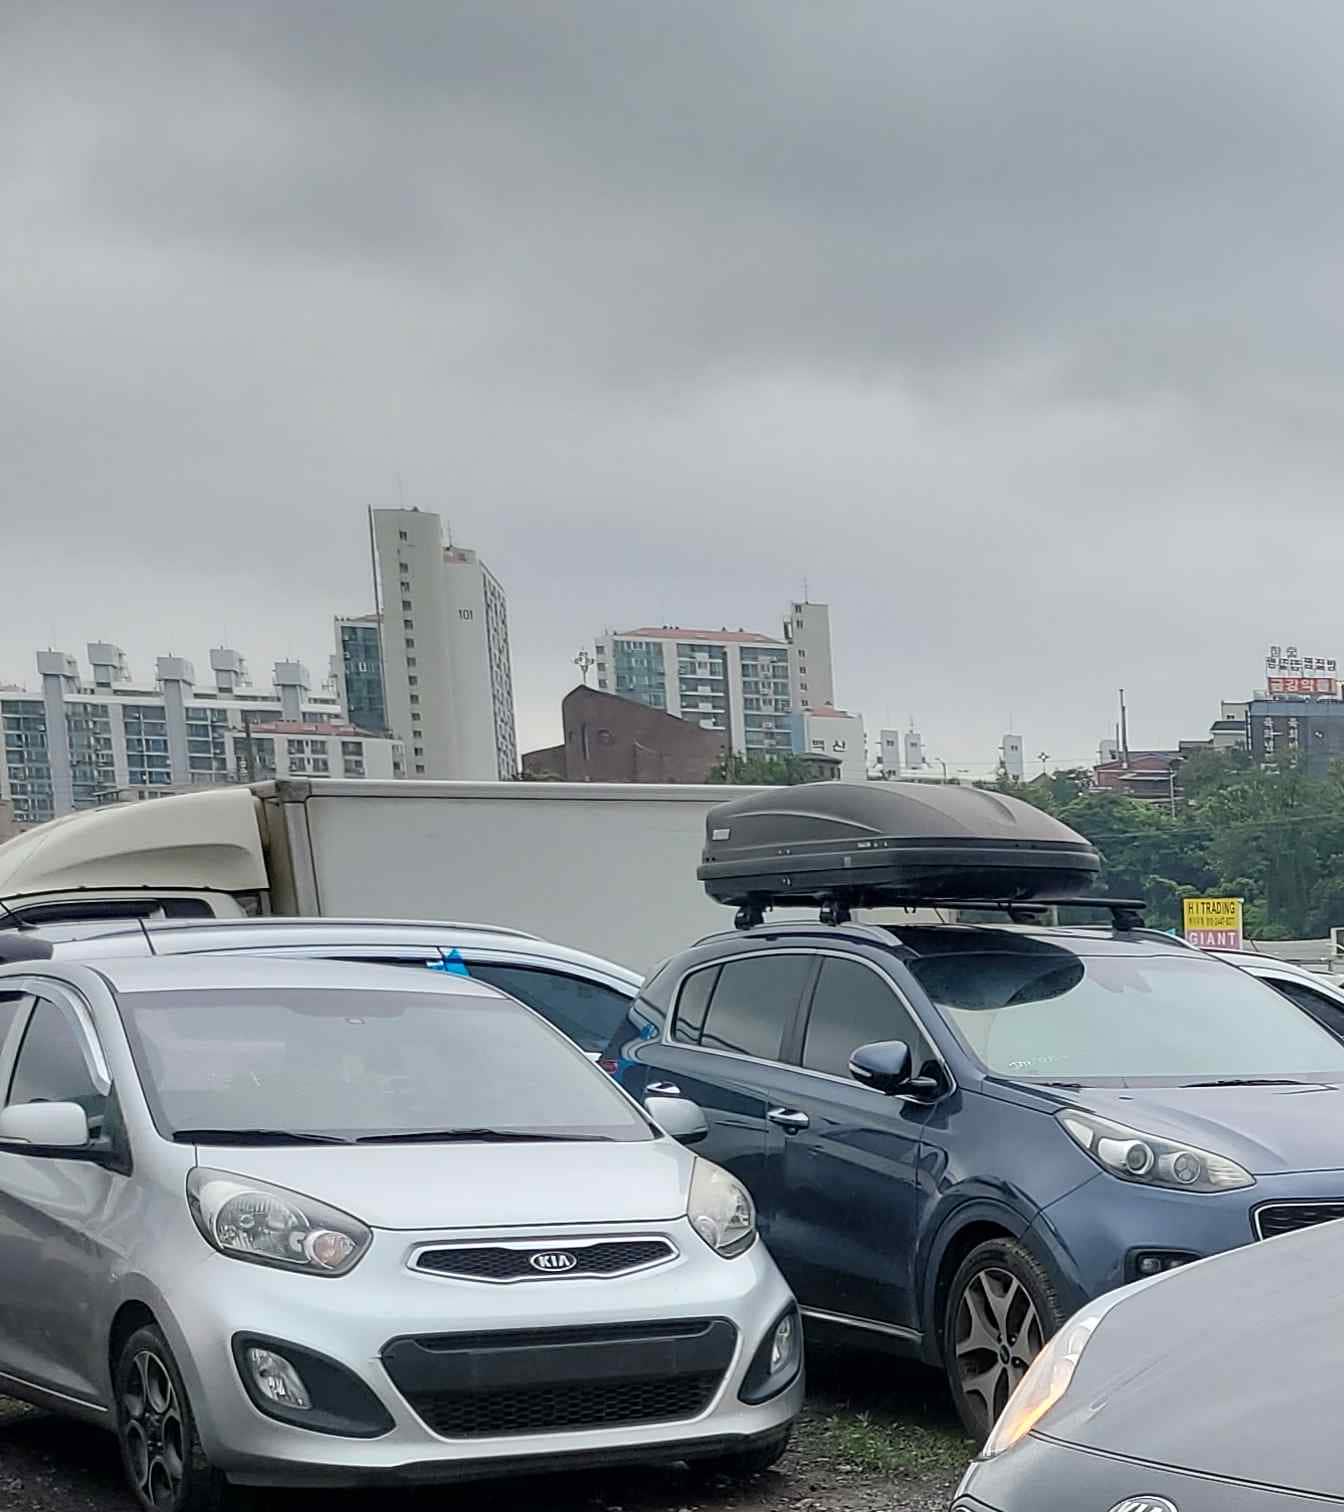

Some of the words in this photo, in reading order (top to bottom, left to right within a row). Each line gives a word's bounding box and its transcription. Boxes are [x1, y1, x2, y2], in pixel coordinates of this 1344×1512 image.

[458, 608, 473, 621] 101
[1201, 902, 1235, 914] TRADING
[1189, 931, 1236, 945] GIANT
